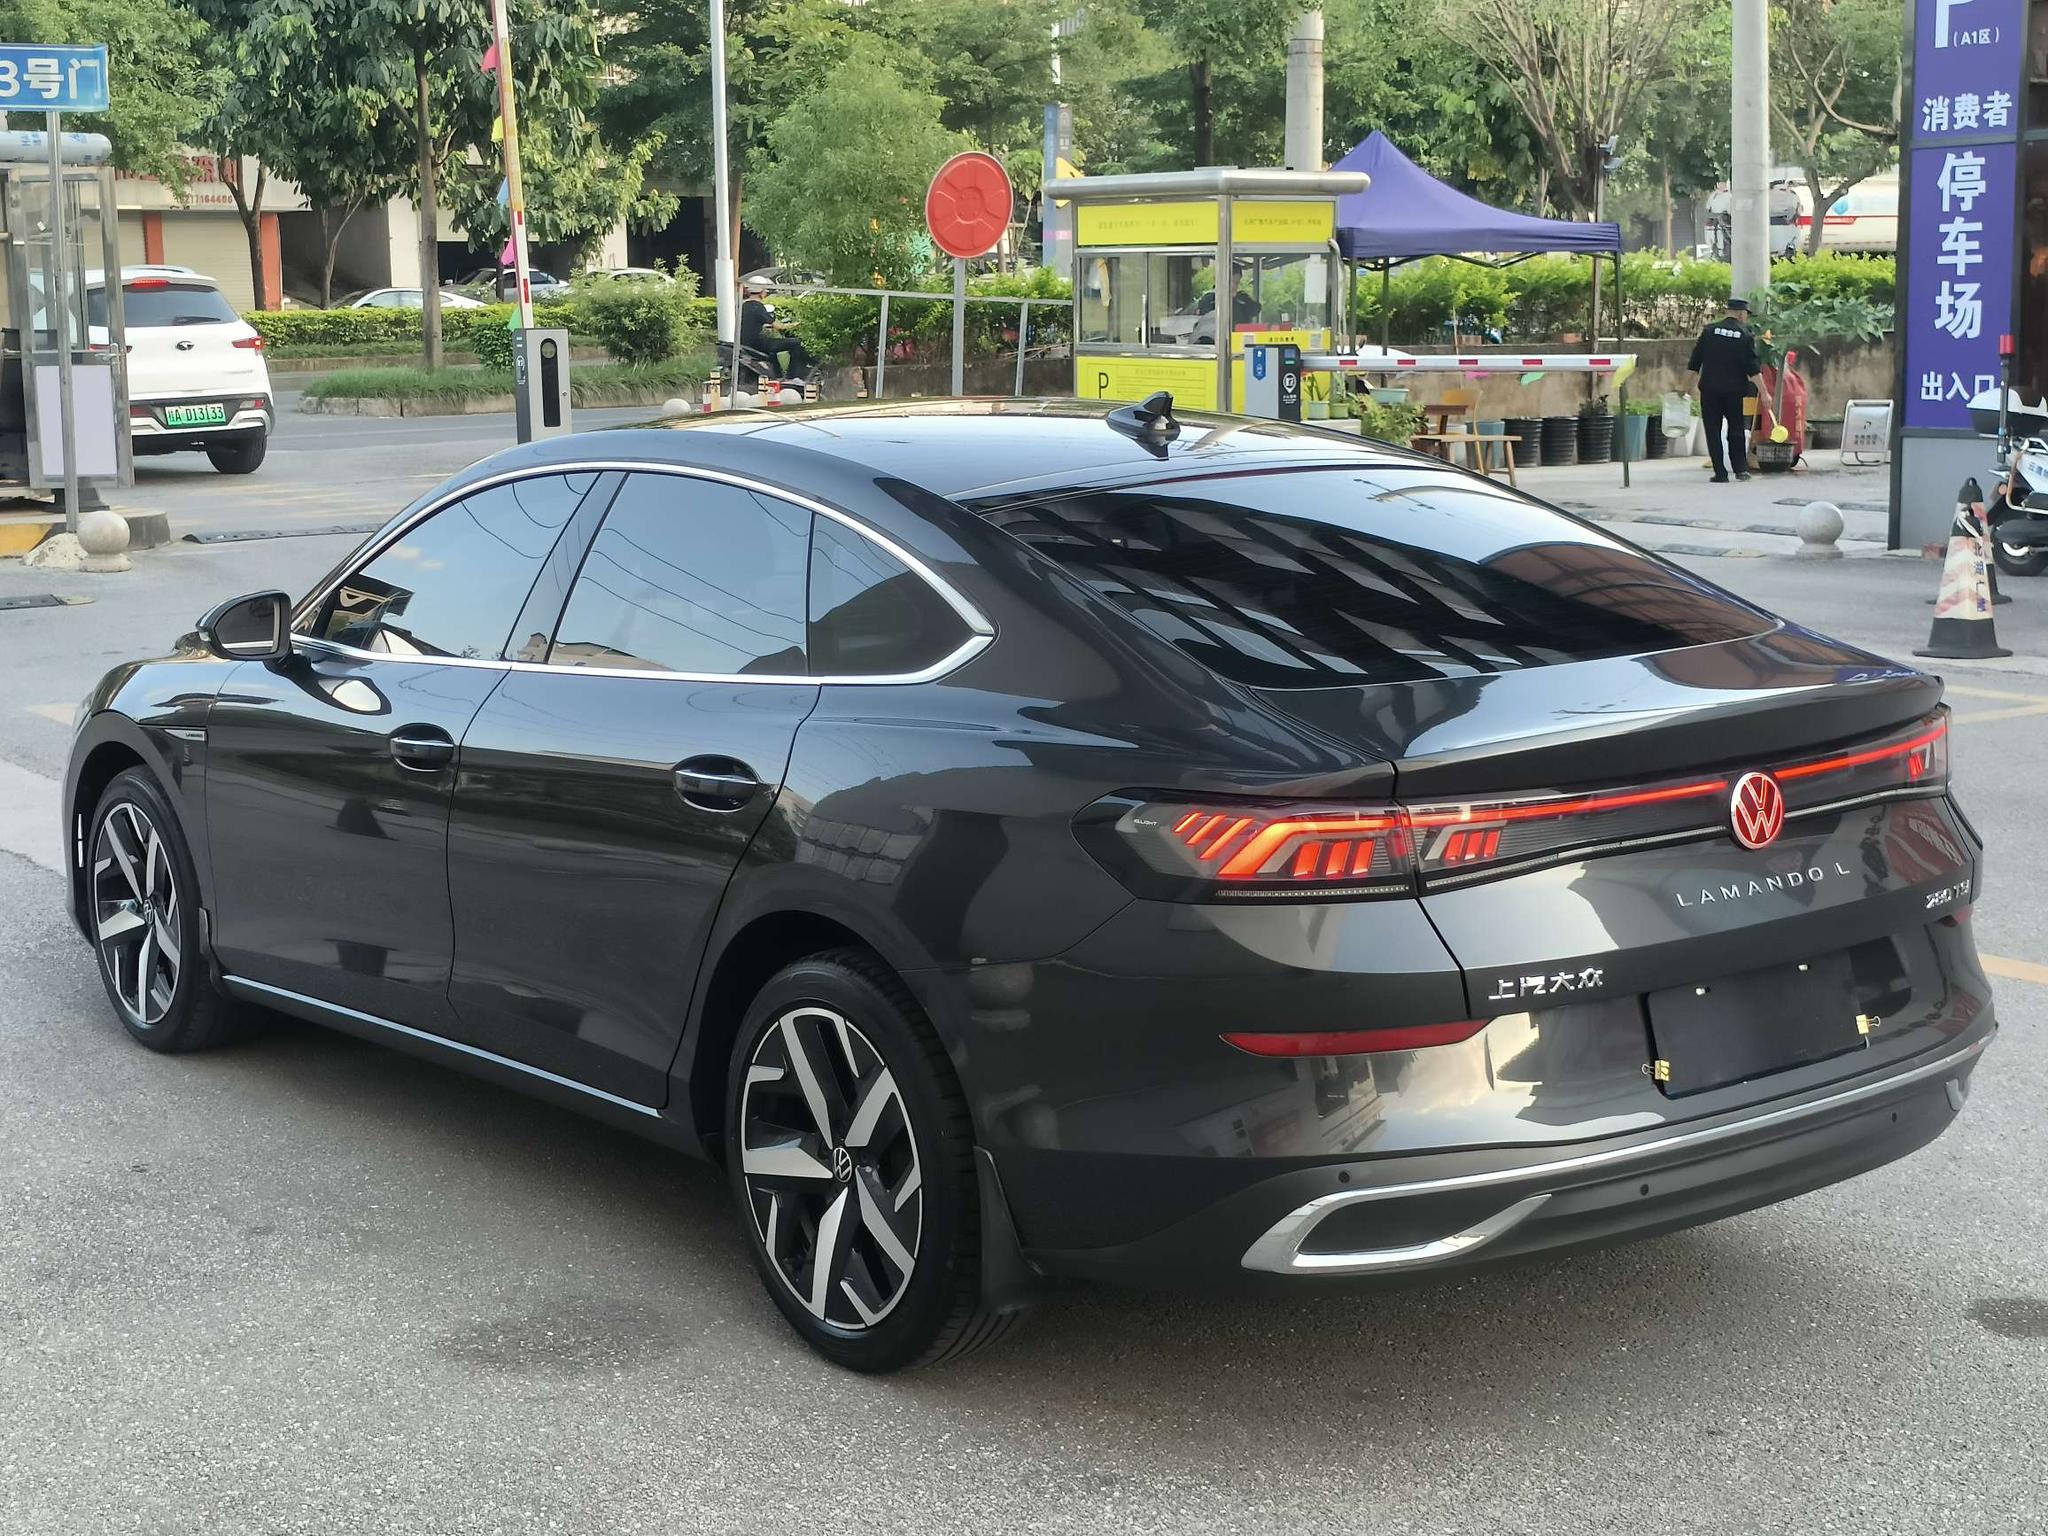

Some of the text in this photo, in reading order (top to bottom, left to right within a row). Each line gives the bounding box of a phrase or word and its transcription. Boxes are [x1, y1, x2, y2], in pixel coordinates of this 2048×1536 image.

[1922, 90, 2013, 132] 消费者
[1934, 150, 1987, 340] 停车场
[1098, 372, 1109, 399] P
[1920, 370, 1995, 402] 出入口
[1676, 860, 1851, 908] LAMANDO L
[1488, 967, 1604, 1001] 上汽大众
